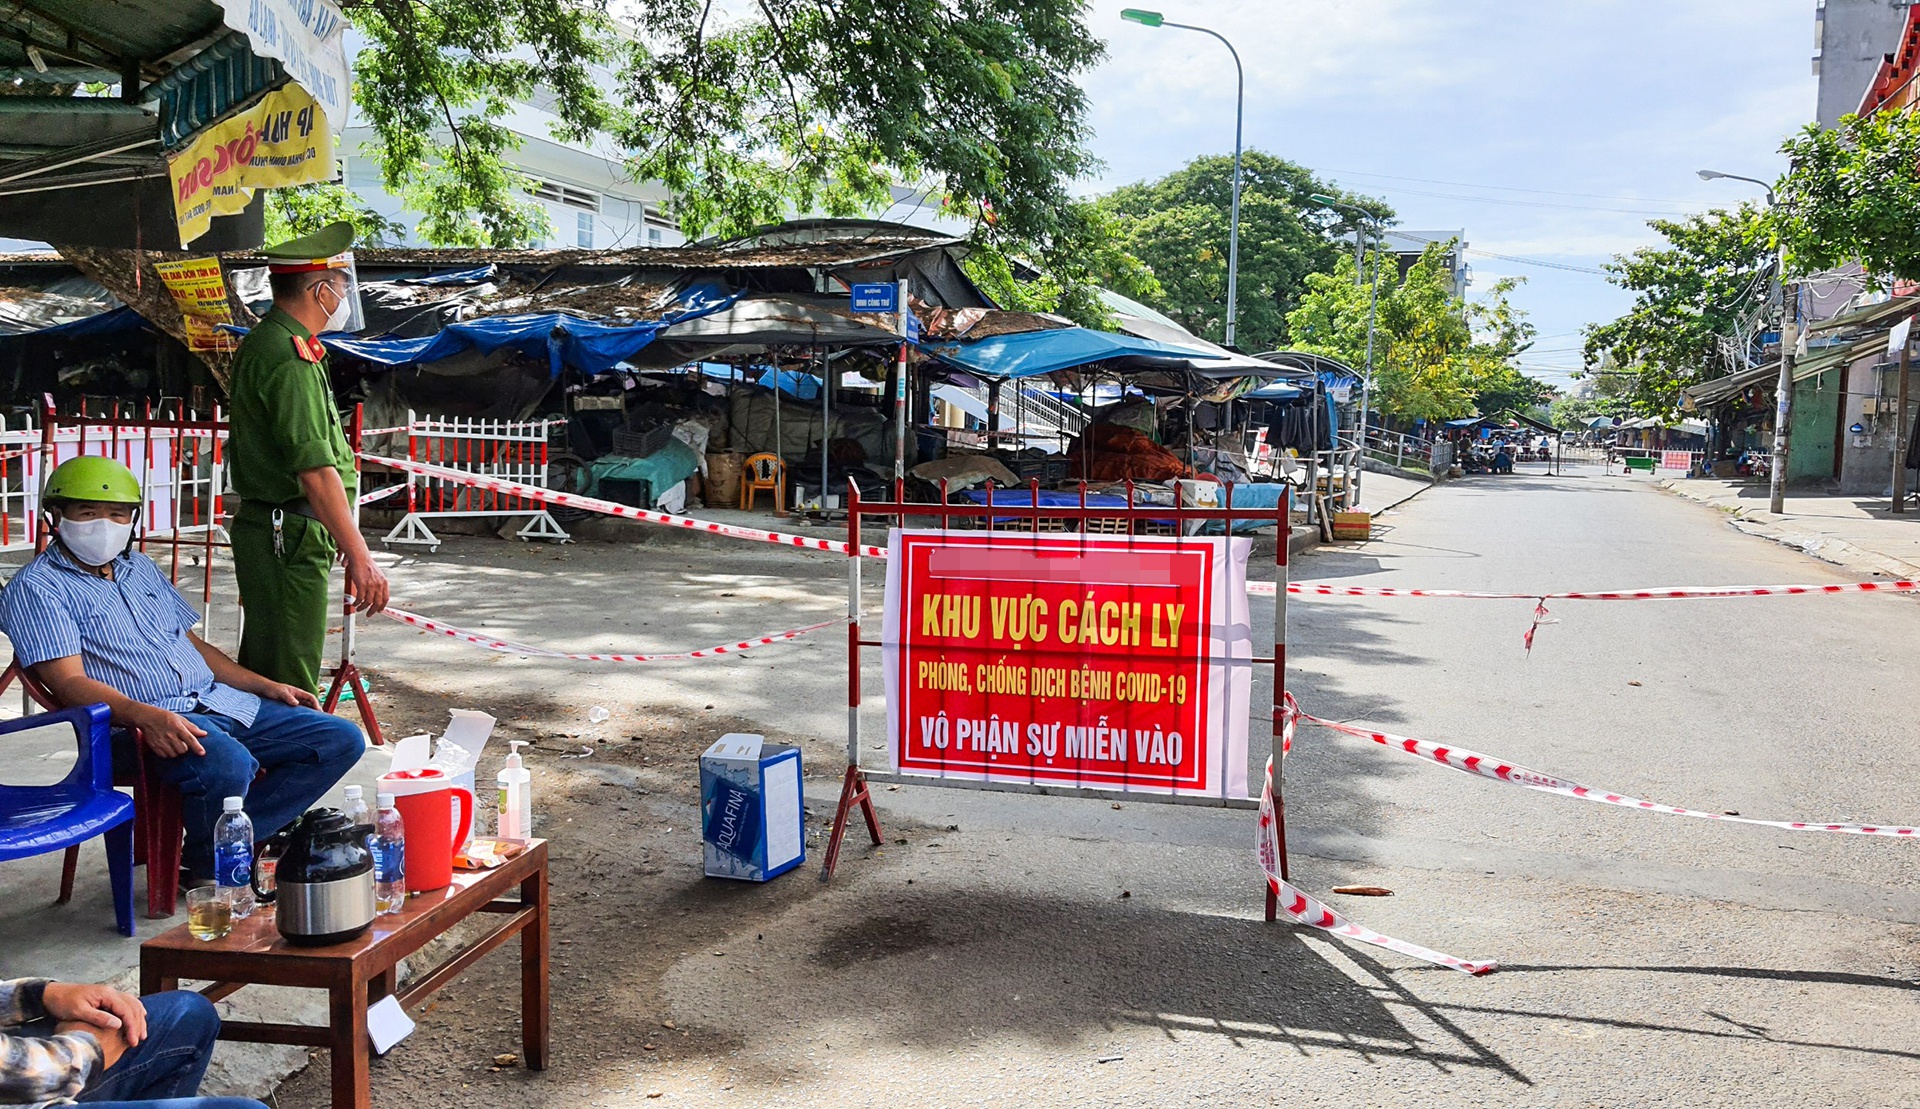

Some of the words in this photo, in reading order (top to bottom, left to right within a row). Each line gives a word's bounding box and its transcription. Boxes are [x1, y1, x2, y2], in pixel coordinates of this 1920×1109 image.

[921, 593, 981, 639] KHU
[990, 592, 1048, 650] VỰC
[1058, 590, 1142, 648] CÁCH
[1151, 602, 1185, 648] LY
[918, 654, 973, 696] PHÒNG,
[976, 655, 1027, 696] CHỐNG
[1030, 668, 1066, 703] DỊCH
[1070, 664, 1111, 706] BỆNH
[1115, 671, 1188, 705] COVID-19
[920, 710, 949, 749] VÔ
[956, 714, 1019, 760] PHẬN
[1026, 721, 1061, 764] SỰ
[1065, 715, 1128, 761] MIỄN
[1134, 723, 1183, 766] VÀO
[716, 789, 748, 853] AQUAFINA
